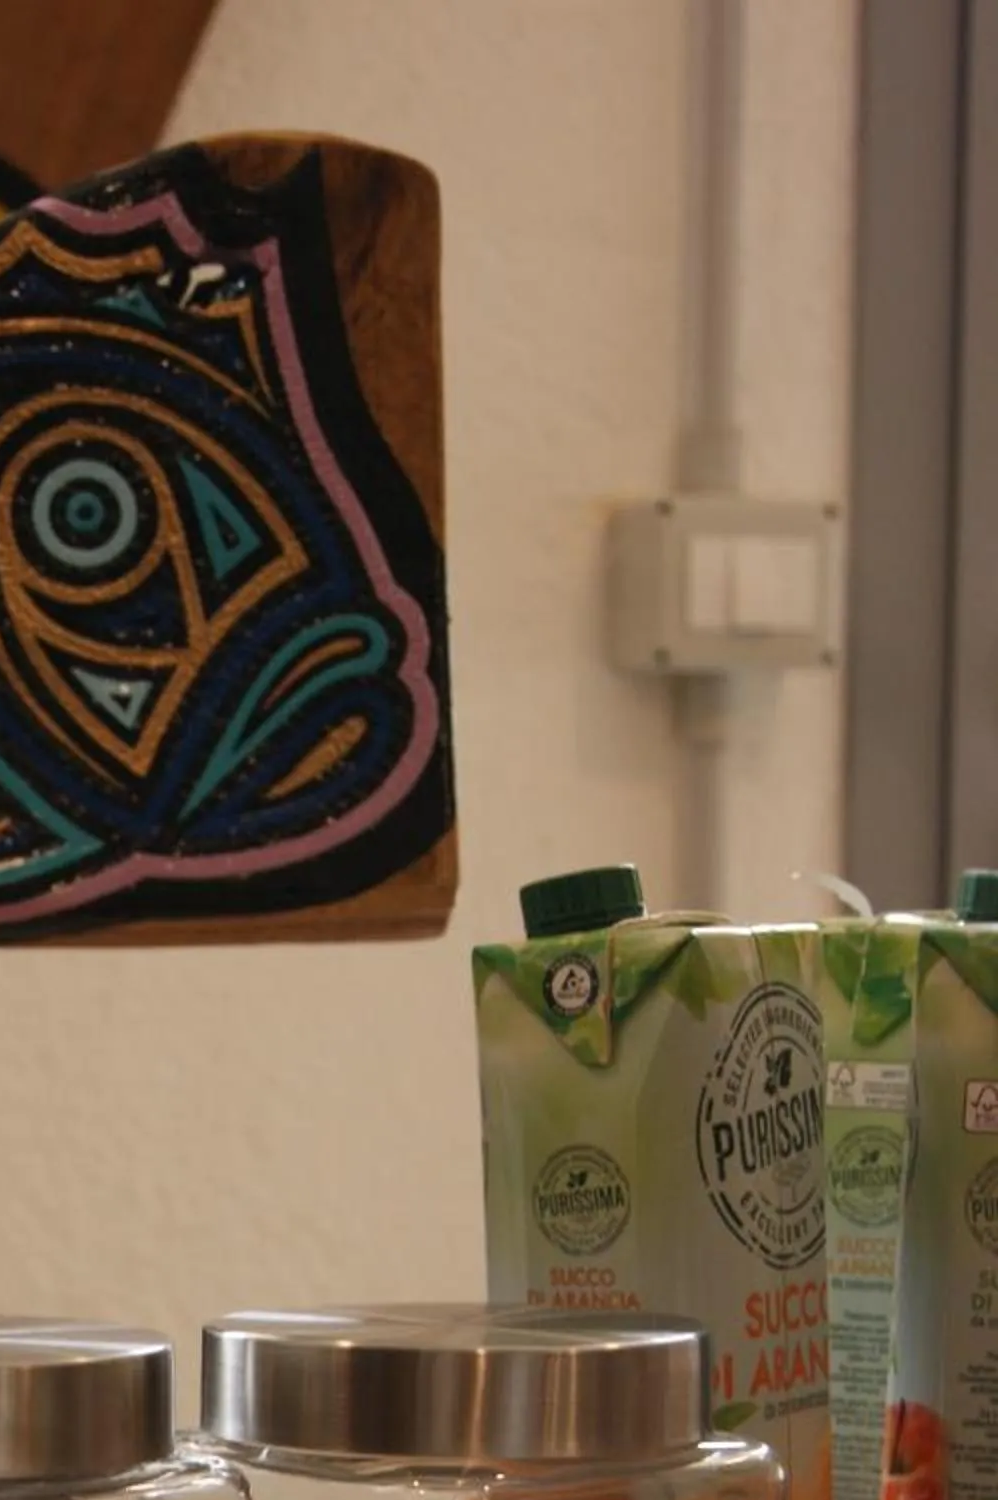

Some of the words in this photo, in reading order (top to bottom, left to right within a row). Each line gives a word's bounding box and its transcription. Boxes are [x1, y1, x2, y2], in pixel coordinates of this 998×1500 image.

[723, 1017, 763, 1108] SELECTED
[538, 1184, 625, 1219] PURISSIMA
[549, 1266, 616, 1287] SUCCO
